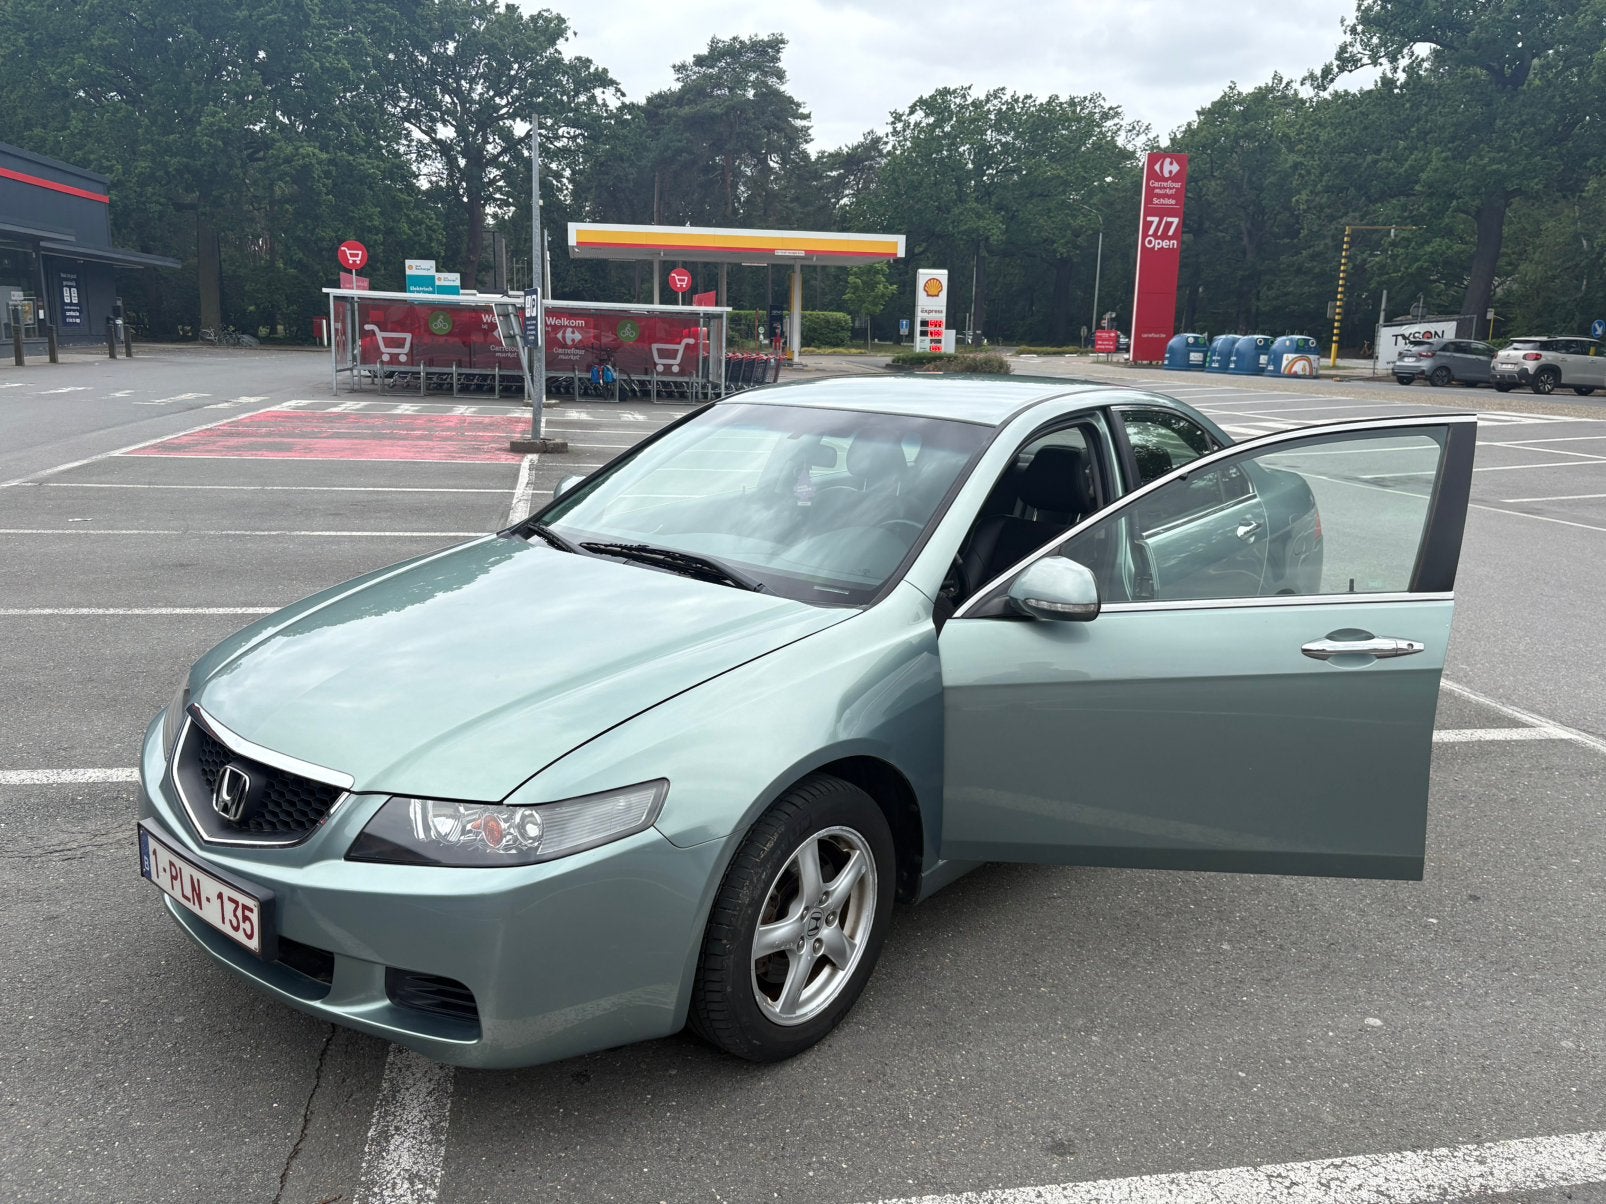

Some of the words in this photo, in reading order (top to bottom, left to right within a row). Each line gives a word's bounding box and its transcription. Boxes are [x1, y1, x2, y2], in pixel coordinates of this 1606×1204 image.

[1149, 180, 1182, 188] Carrefour
[1152, 197, 1176, 205] Schilde
[1146, 216, 1179, 236] 7/7
[1145, 237, 1177, 250] Open
[545, 316, 585, 327] Welkom
[489, 344, 520, 352] Carrefou
[553, 347, 585, 355] Carrefour
[143, 856, 150, 871] B
[152, 848, 255, 940] 1-PLN-135
